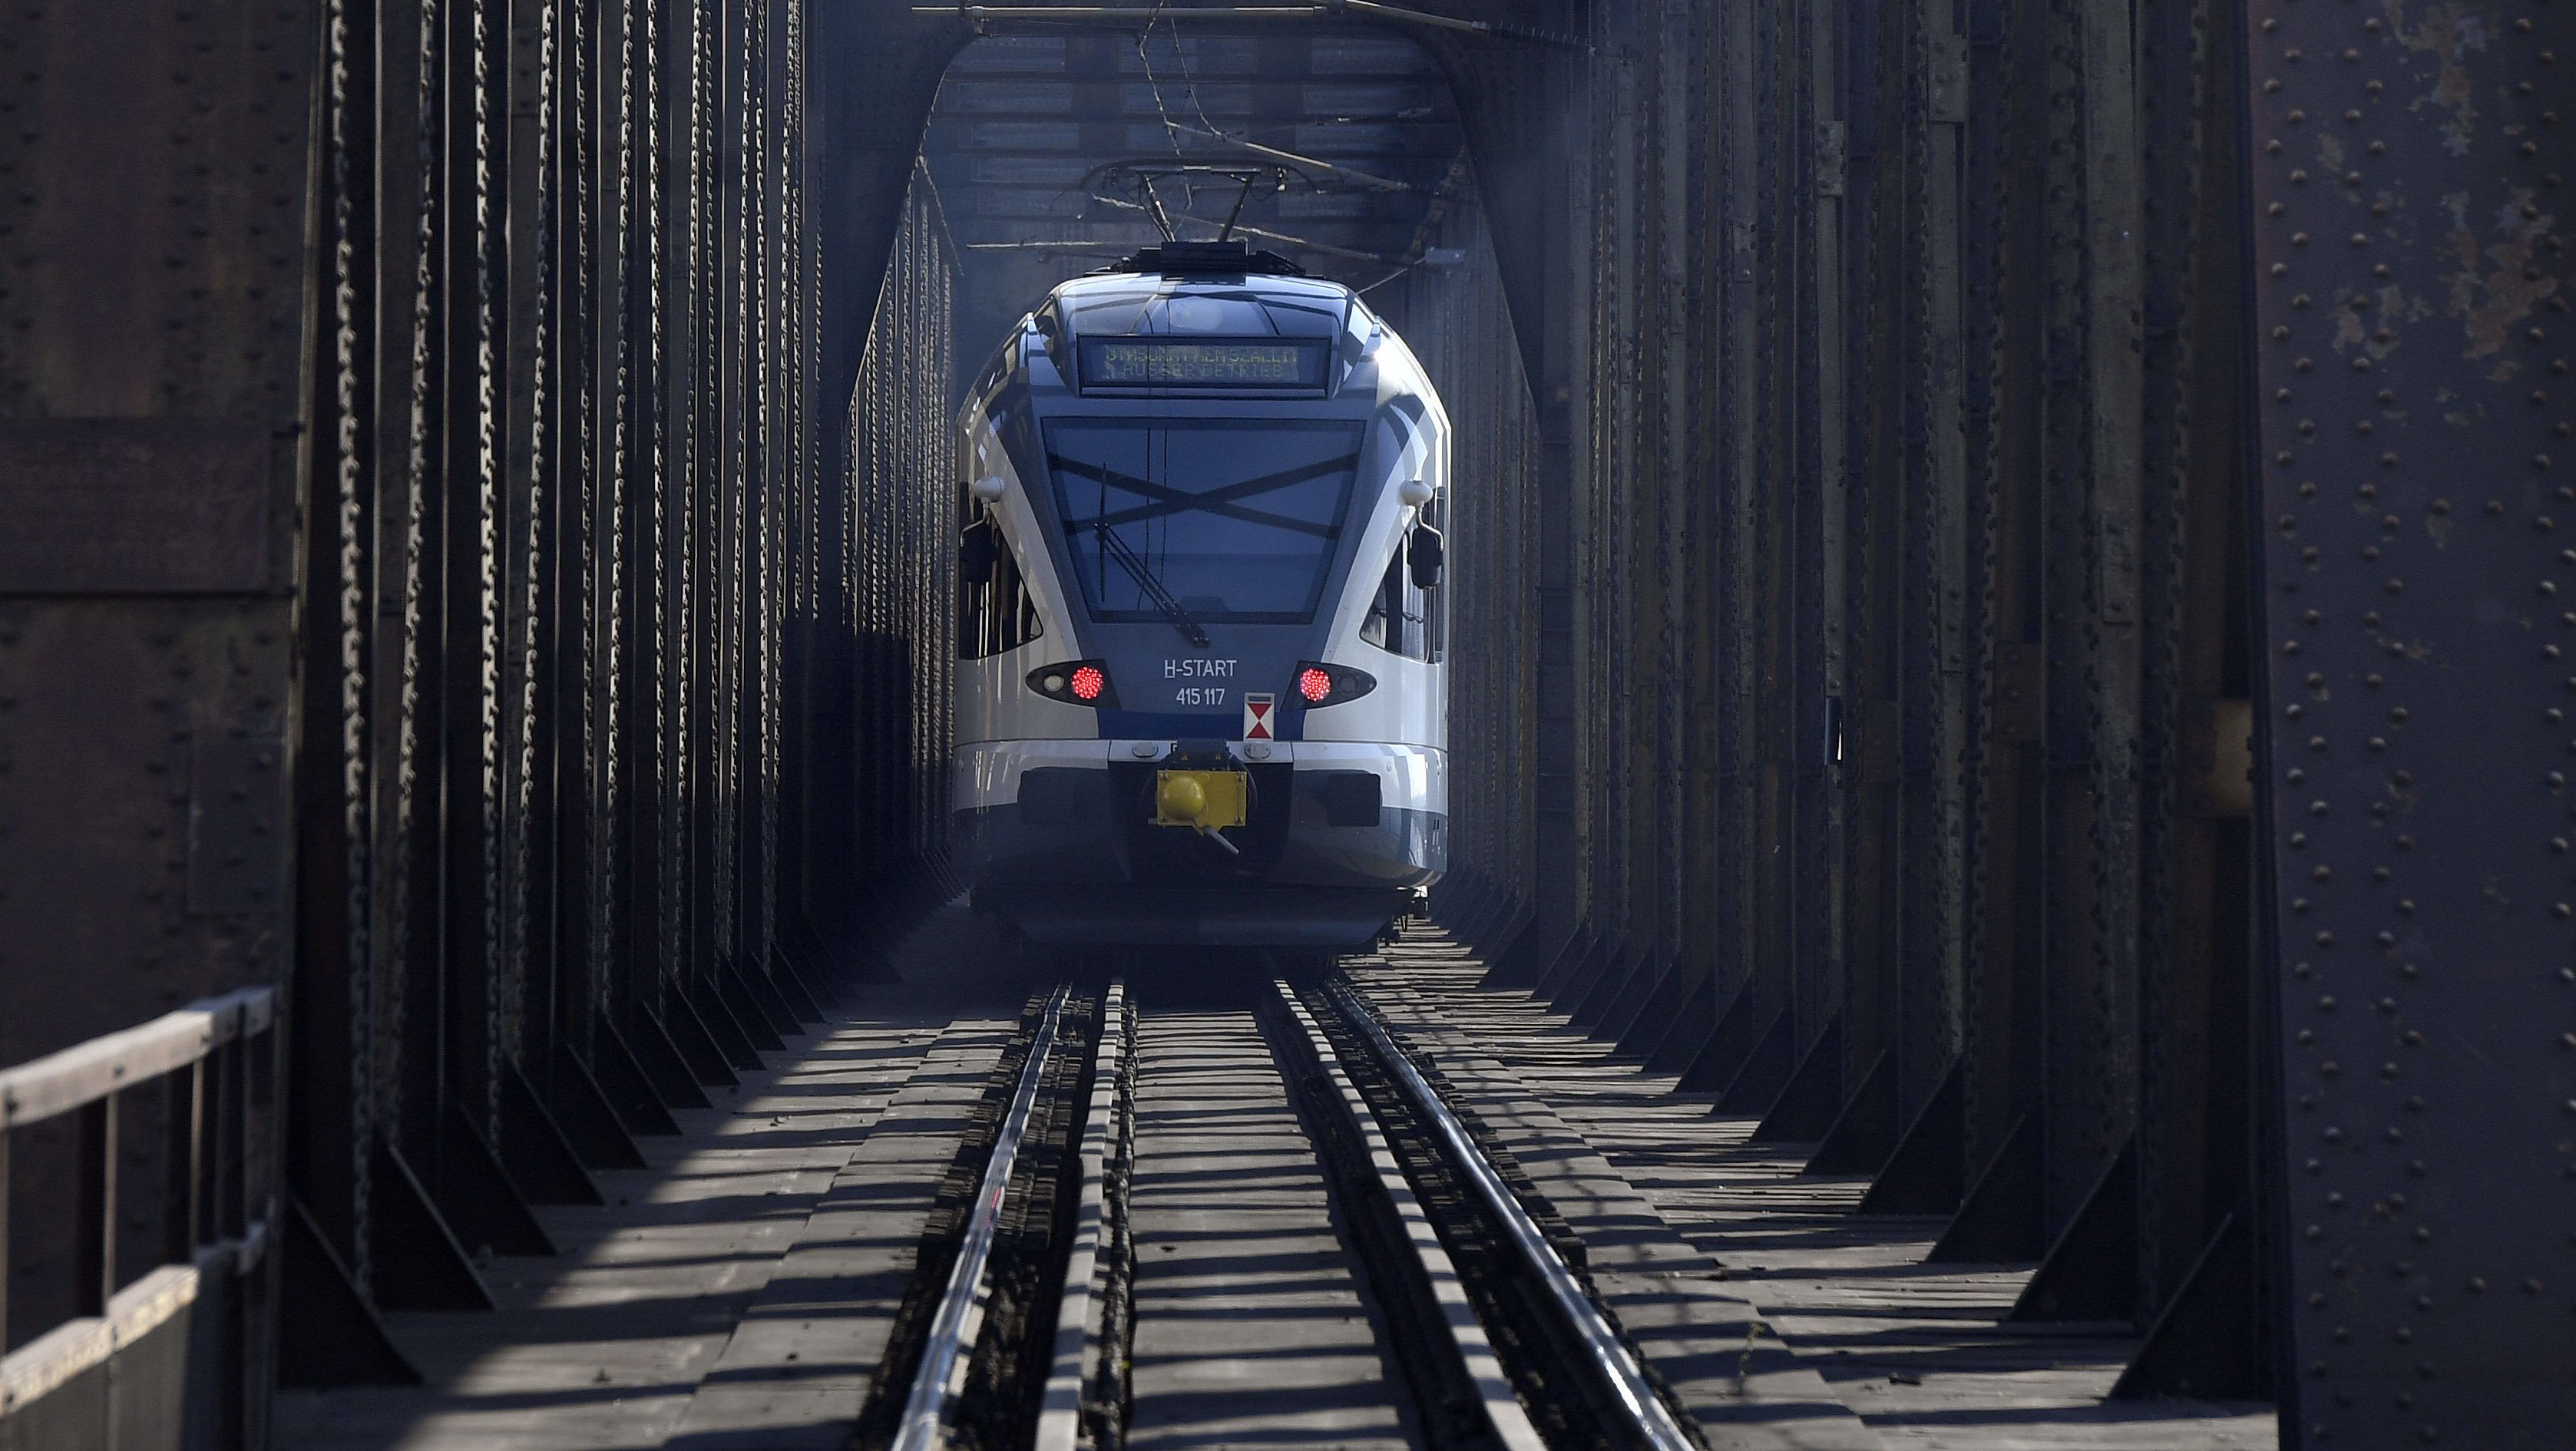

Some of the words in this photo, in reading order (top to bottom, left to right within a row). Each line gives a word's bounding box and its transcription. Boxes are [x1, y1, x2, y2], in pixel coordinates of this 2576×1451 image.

[1164, 659, 1237, 678] H-START
[1176, 688, 1201, 705] 415
[1205, 688, 1225, 705] 117
